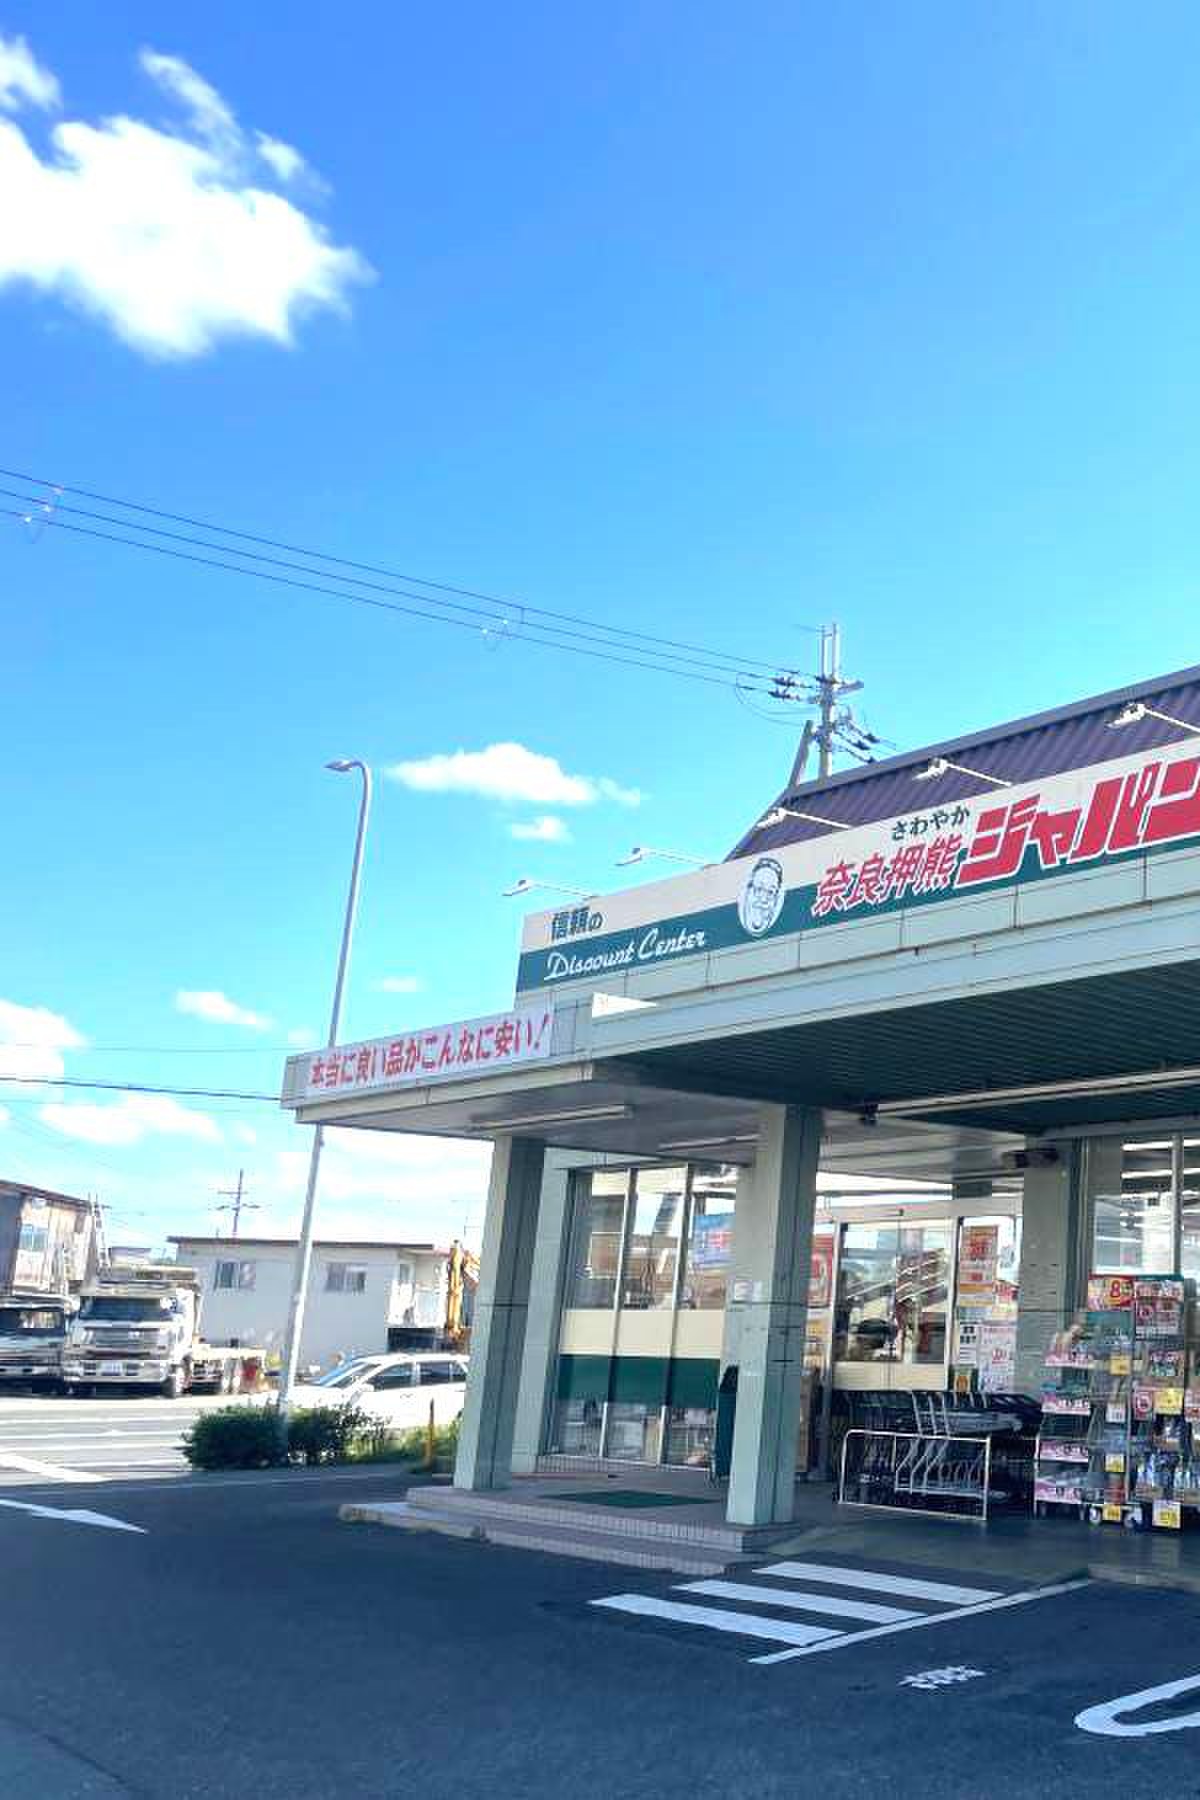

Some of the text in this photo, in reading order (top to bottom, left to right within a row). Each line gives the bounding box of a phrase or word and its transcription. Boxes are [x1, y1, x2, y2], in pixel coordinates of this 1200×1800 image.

[891, 804, 970, 842] さわやか
[543, 927, 706, 981] Discount Center
